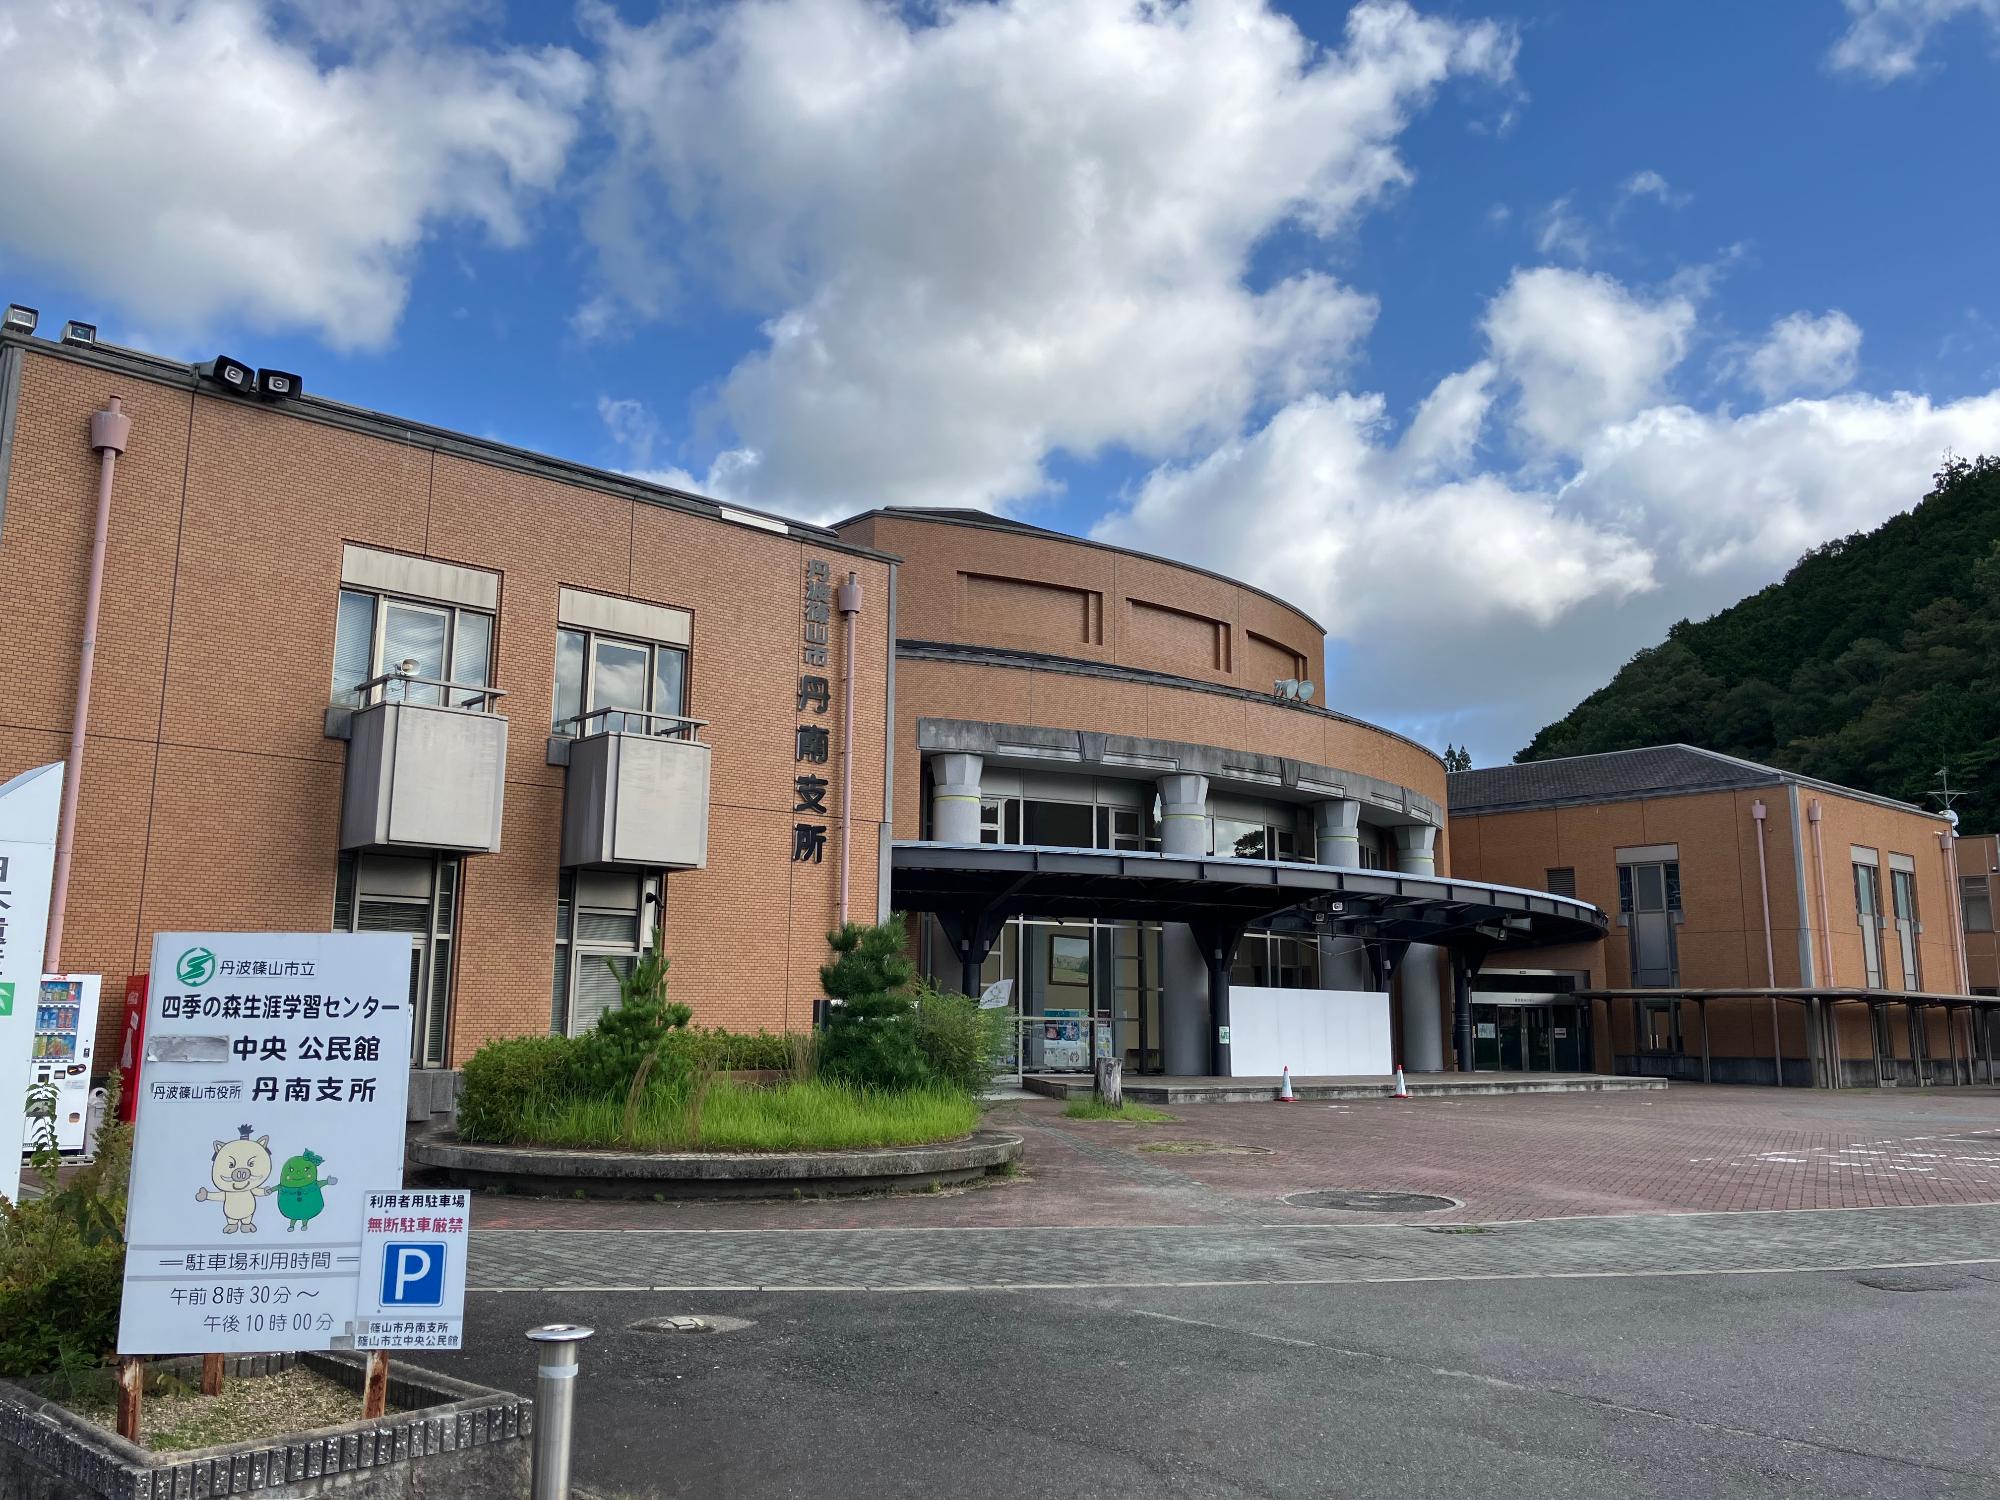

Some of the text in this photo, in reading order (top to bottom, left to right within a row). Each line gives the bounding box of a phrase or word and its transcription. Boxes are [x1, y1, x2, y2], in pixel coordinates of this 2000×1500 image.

[793, 673, 831, 864] 丹南支所
[219, 959, 316, 977] 丹波篠山市立
[161, 993, 400, 1020] 四季の森生涯学習センター
[153, 1075, 377, 1103] 丹波篠山市役所 丹南支所
[369, 1194, 466, 1209] 利用者用駐車場
[367, 1216, 464, 1234] 無断駐車厳禁
[185, 1251, 331, 1271] 駐車場利用時間
[394, 1248, 431, 1300] P
[370, 1321, 449, 1334] 篠山市丹南支所
[357, 1335, 459, 1347] 篠山市立中央公民館
